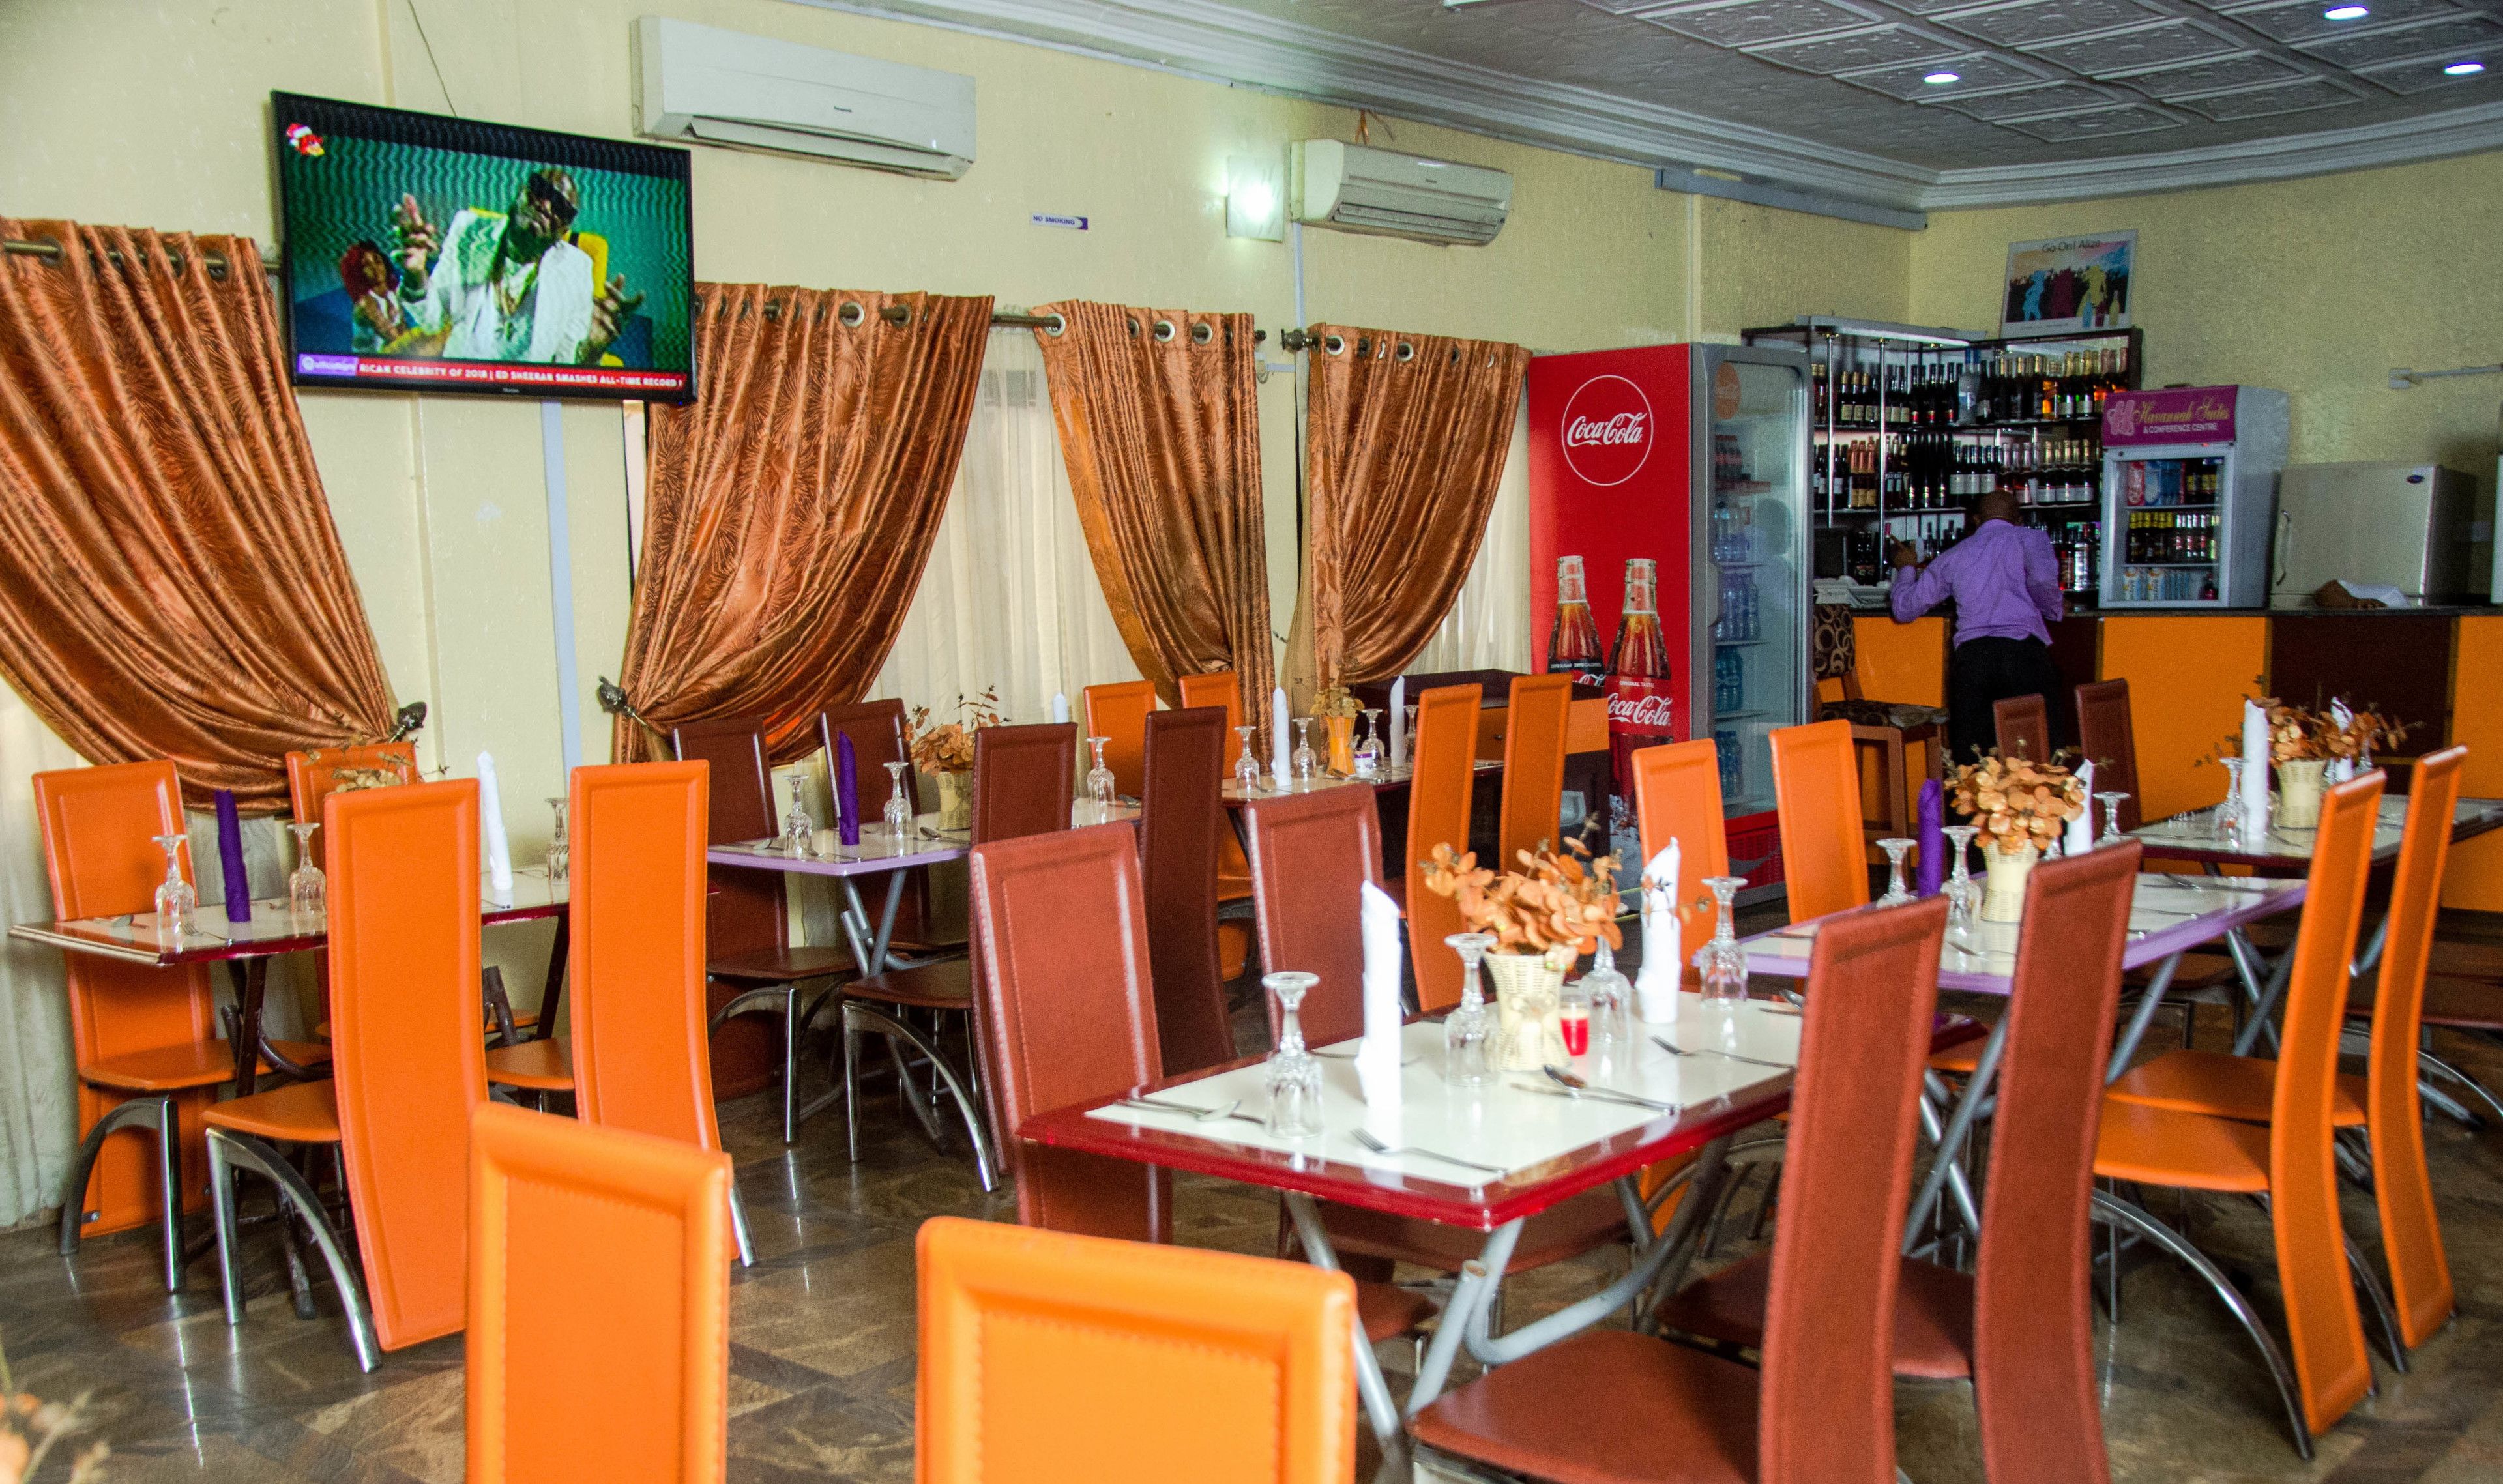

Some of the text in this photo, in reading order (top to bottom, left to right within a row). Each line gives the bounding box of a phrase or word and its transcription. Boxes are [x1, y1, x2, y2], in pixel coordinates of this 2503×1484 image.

[1045, 216, 1075, 225] SMOKING
[393, 365, 446, 376] CELEBRITY
[448, 368, 463, 377] OF
[495, 370, 508, 379] ED
[510, 371, 553, 381] SHEERAN
[555, 373, 598, 383] SMASHES
[643, 377, 677, 387] RECORD
[1567, 412, 1648, 446] Coca-Cola
[2149, 424, 2191, 433] CONFERENCE
